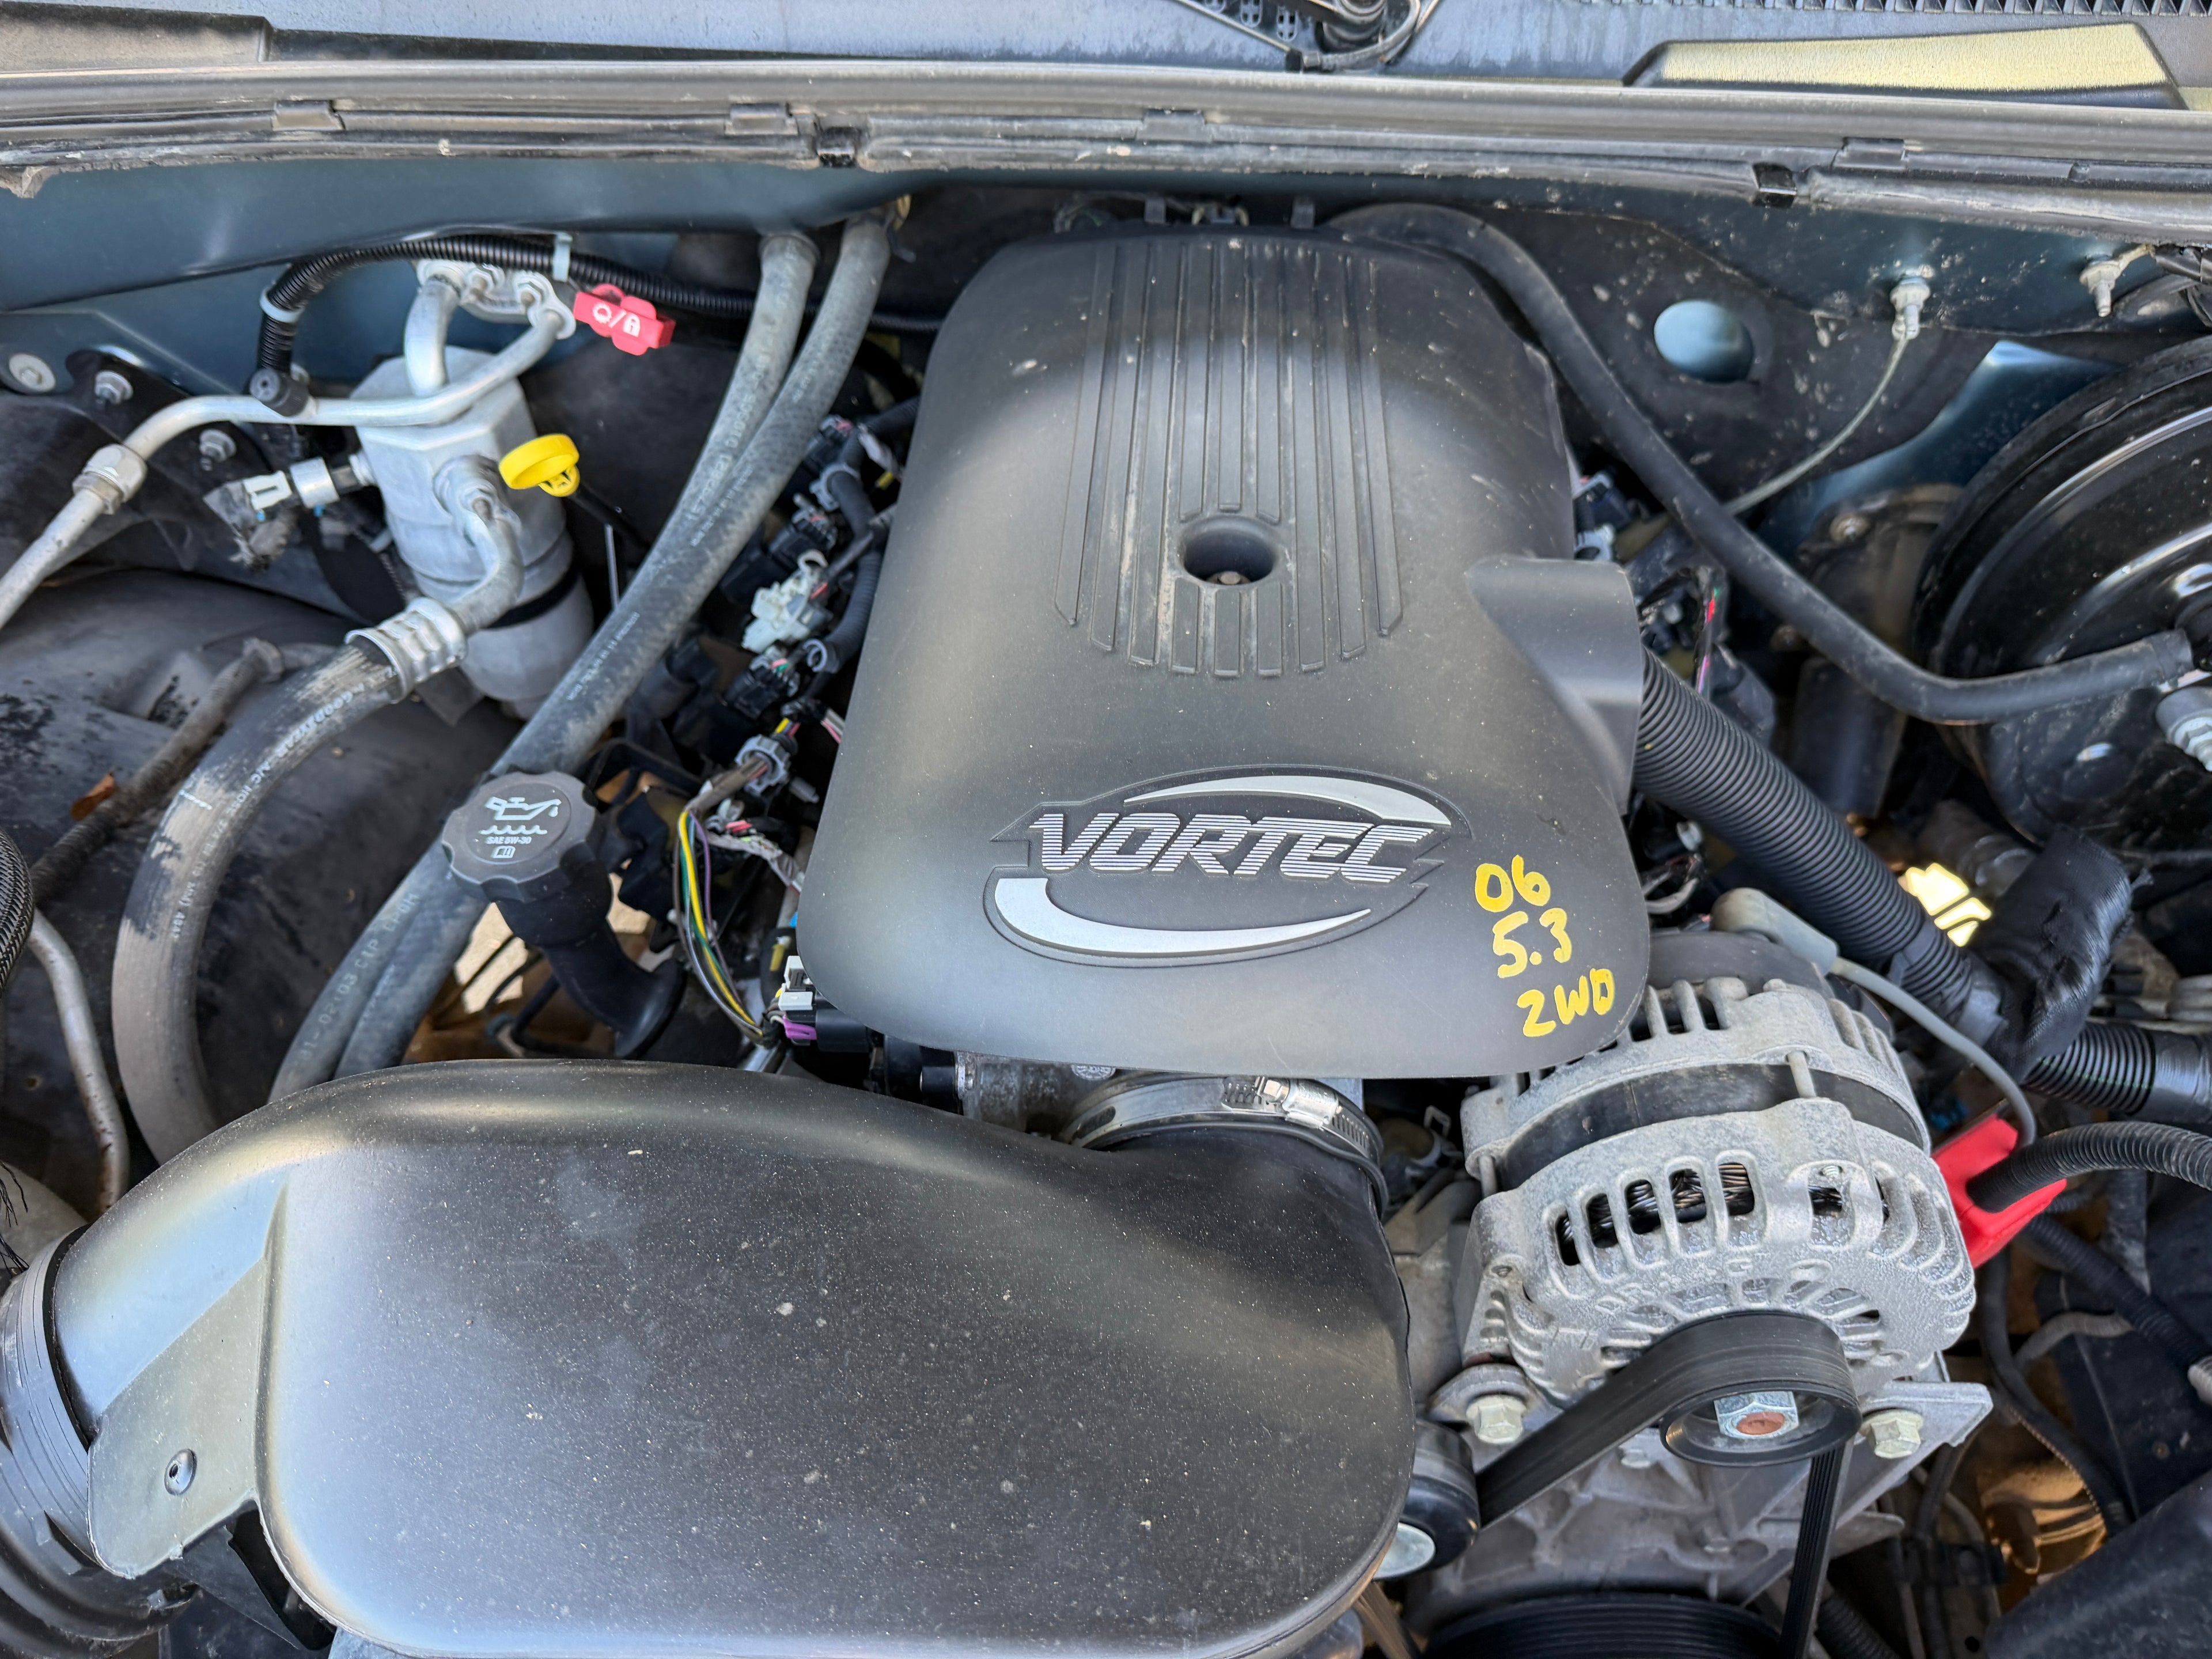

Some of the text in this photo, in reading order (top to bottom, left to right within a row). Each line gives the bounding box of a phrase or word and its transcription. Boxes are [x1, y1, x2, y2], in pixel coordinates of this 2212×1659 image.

[486, 836, 532, 844] SAE 5W-30
[1028, 812, 1434, 883] VORTEC
[1474, 854, 1551, 912] 06
[1491, 907, 1573, 979] 5.3
[1516, 967, 1616, 1037] 2WD
